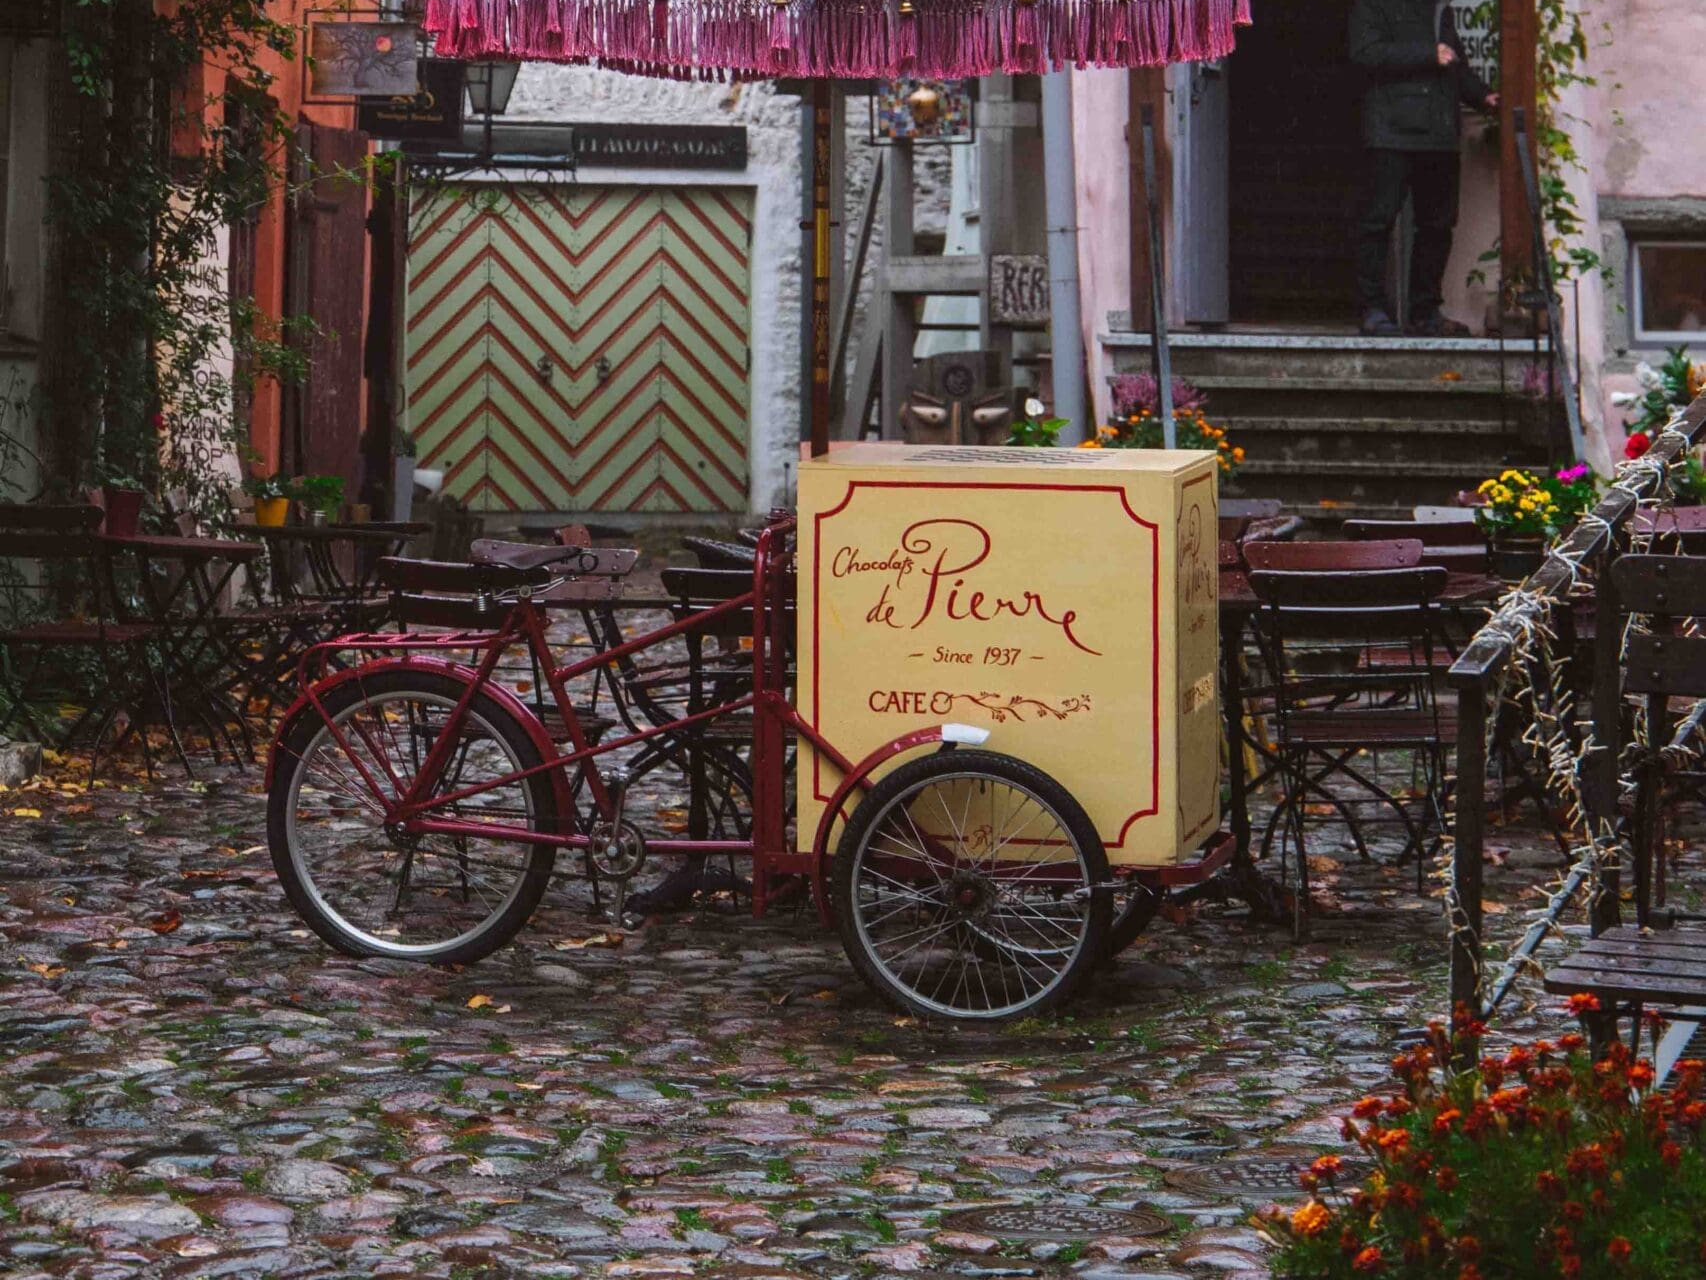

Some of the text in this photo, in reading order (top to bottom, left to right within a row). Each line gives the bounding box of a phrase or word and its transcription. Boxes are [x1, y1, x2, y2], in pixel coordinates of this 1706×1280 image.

[832, 546, 915, 590] Chocolats
[866, 583, 905, 629] de
[902, 518, 1104, 657] Pierre
[932, 646, 1022, 666] Since 1937
[868, 690, 927, 715] CAFE
